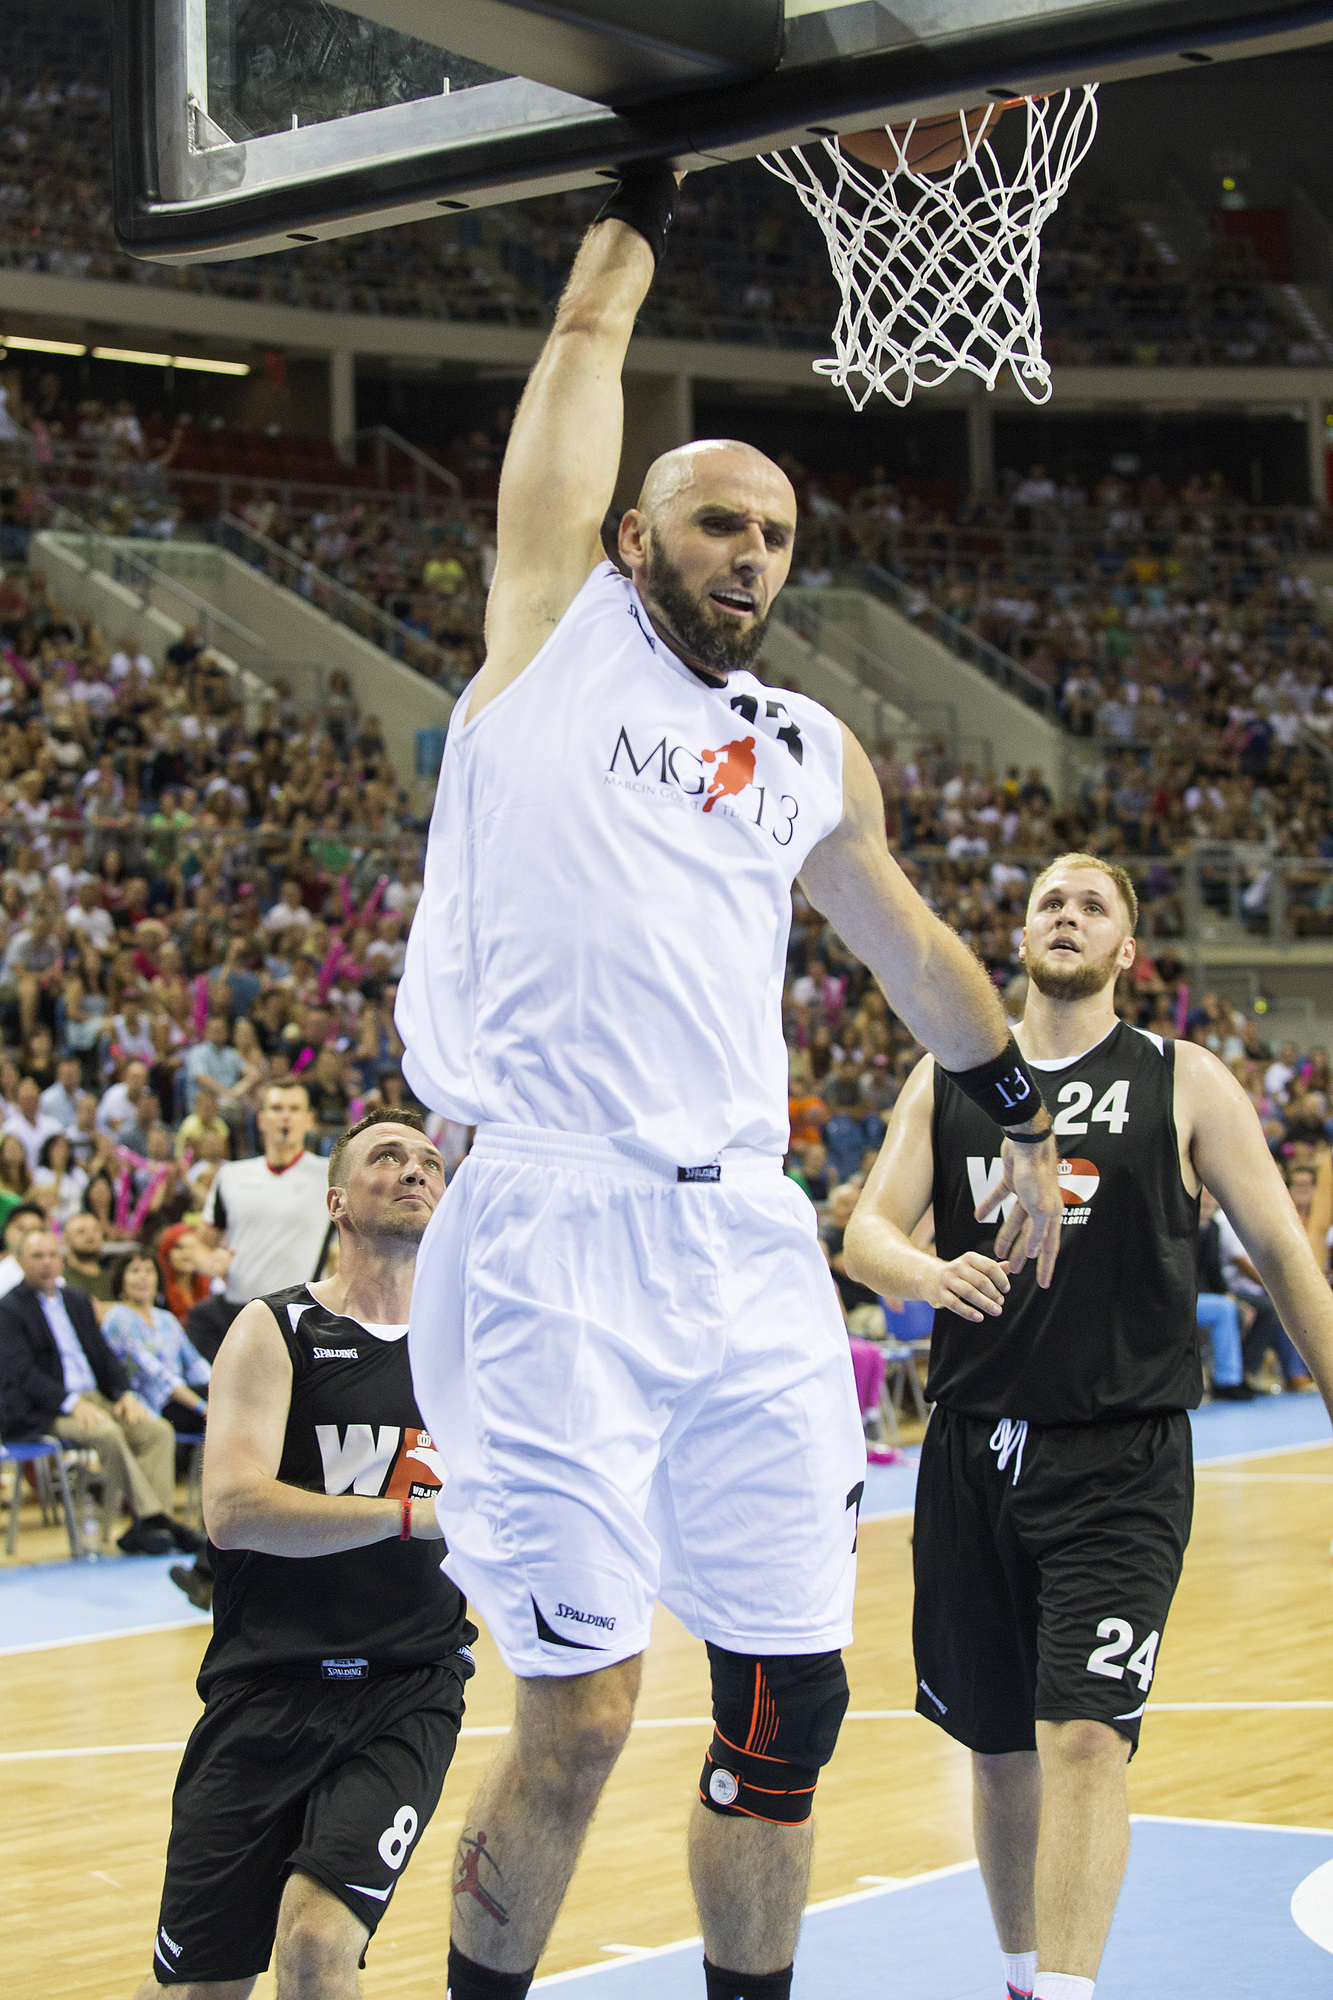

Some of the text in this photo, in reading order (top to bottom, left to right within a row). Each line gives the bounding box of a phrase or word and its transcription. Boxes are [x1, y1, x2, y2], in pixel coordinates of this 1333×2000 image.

[602, 776, 656, 795] MARCIN
[1052, 1080, 1131, 1136] 24
[1060, 1216, 1090, 1225] LSKIE
[1061, 1207, 1092, 1217] OJSKO
[313, 1347, 359, 1360] SPALDING
[555, 1603, 617, 1631] SPALDING
[1086, 1617, 1160, 1692] 24
[327, 1667, 362, 1677] SPALDING
[378, 1804, 419, 1871] 8
